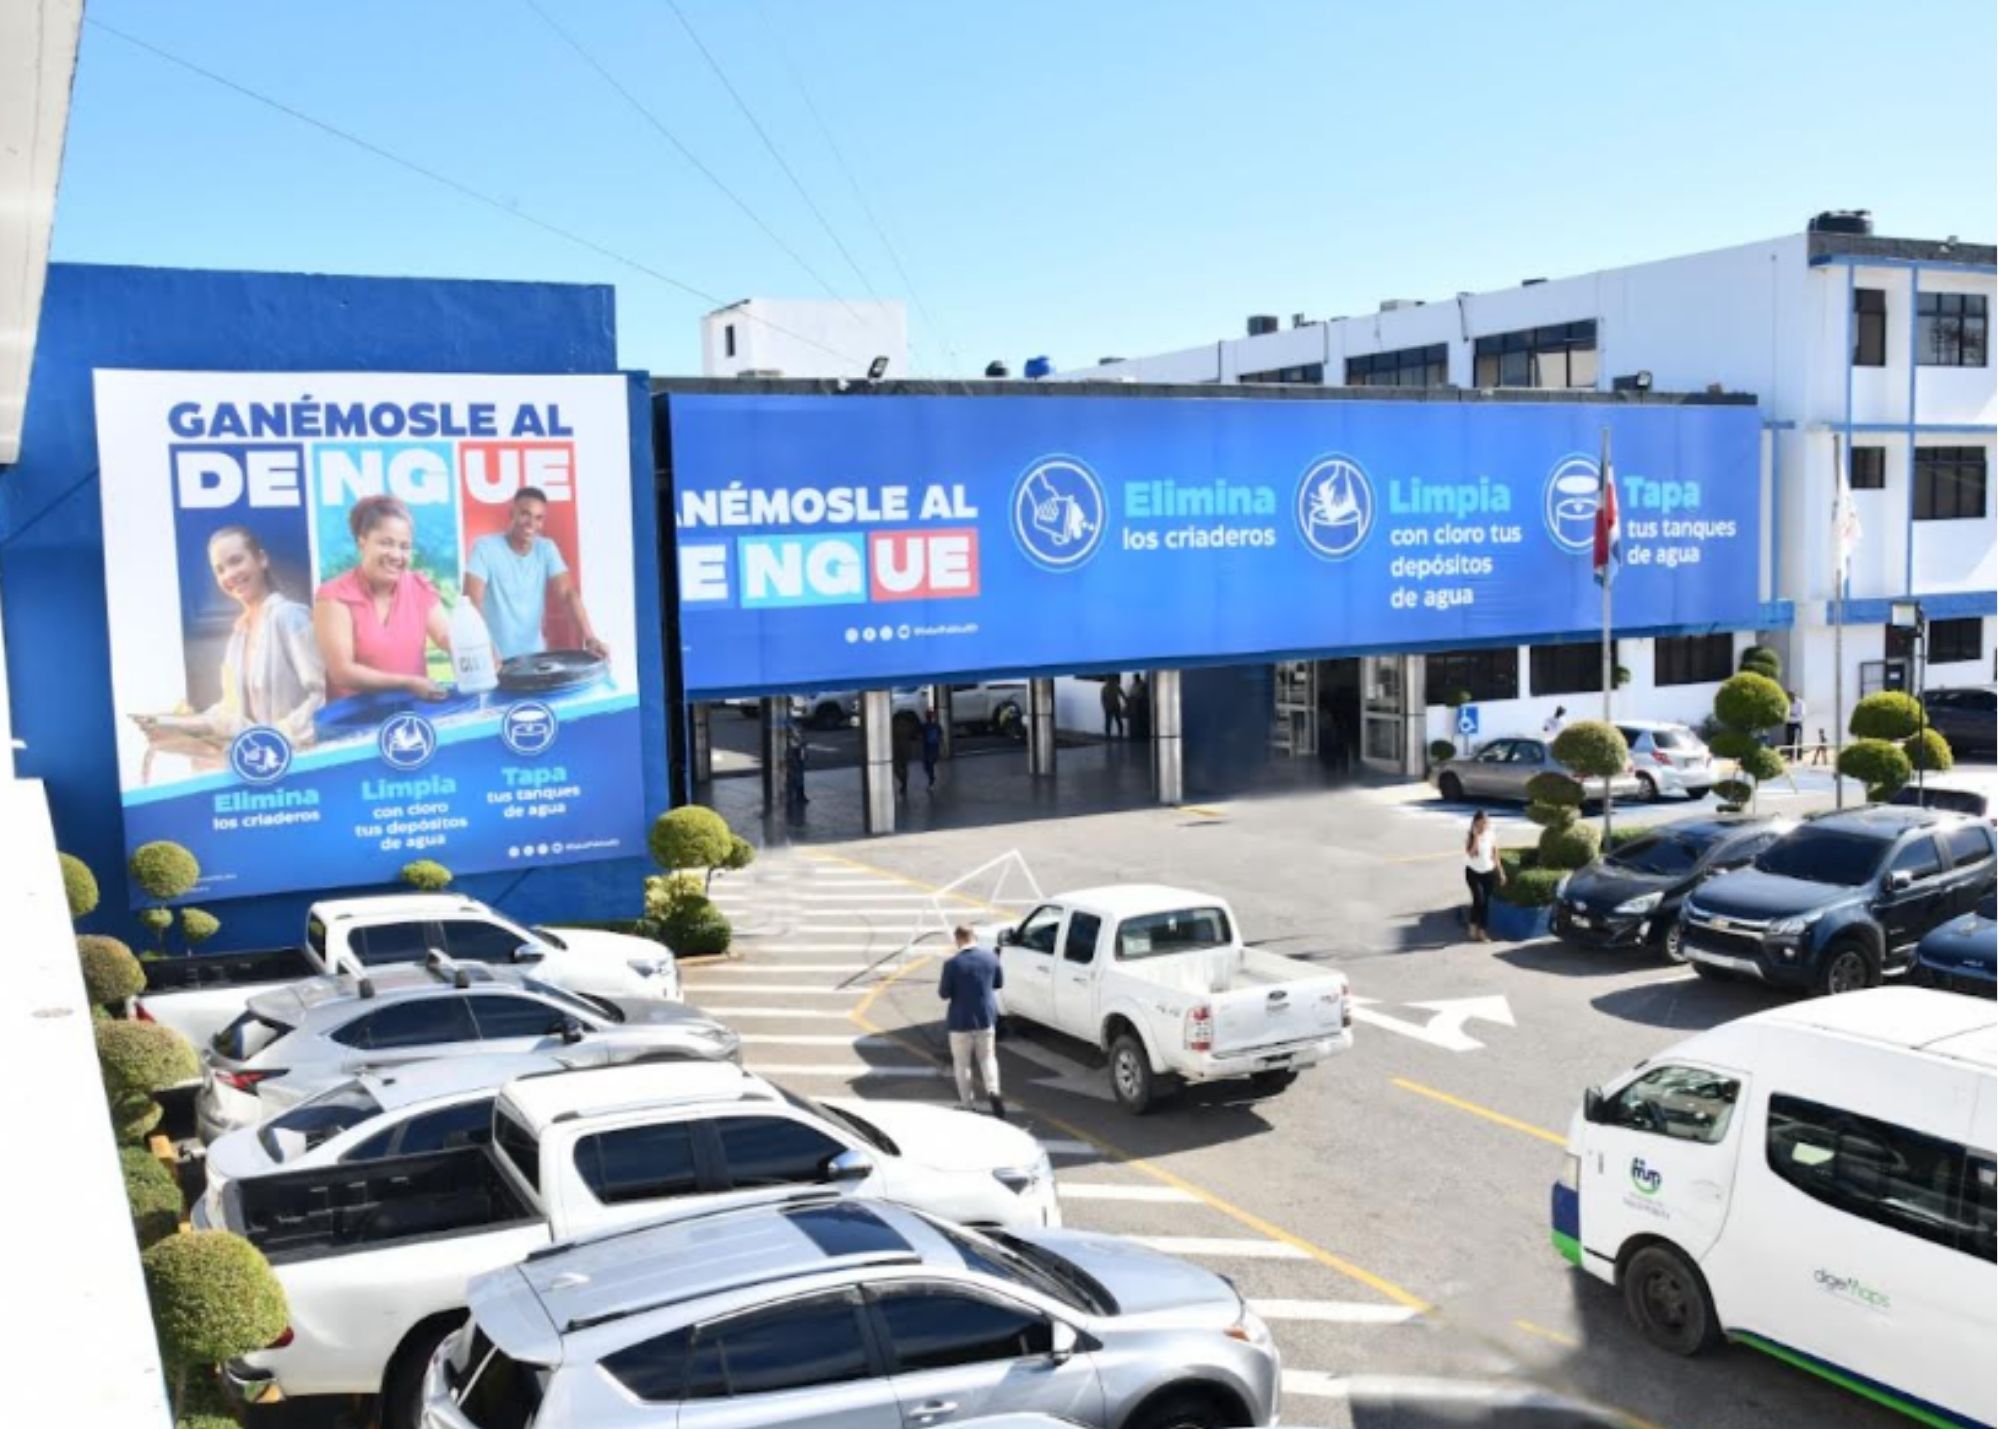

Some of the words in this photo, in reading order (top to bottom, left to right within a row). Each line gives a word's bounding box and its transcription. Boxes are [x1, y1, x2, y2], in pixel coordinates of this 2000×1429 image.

[168, 394, 497, 437] GANÉMOSLE
[510, 403, 573, 436] AL
[676, 481, 909, 527] NÉMOSLE
[919, 484, 978, 518] AL
[1125, 479, 1276, 517] Elimina
[1390, 476, 1511, 517] Limpia
[1624, 476, 1700, 514] Tapa
[1123, 528, 1158, 550] los
[1165, 524, 1276, 548] criaderos
[1390, 529, 1428, 545] con
[1434, 524, 1482, 544] cloro
[1491, 524, 1521, 542] tus
[1627, 521, 1657, 538] tus
[1662, 519, 1736, 541] tanques
[1627, 545, 1652, 564] de
[1656, 548, 1699, 566] agua
[1390, 555, 1492, 580] depósitos
[1390, 588, 1416, 609] de
[1424, 587, 1474, 610] agua
[502, 766, 566, 788] Tapa
[362, 775, 457, 802] Limpia
[487, 790, 512, 803] tus
[516, 785, 580, 802] tanques
[214, 788, 319, 813] Elimina
[373, 806, 403, 818] con
[407, 802, 449, 816] cloro
[503, 805, 523, 818] de
[527, 803, 566, 818] agua
[214, 816, 238, 830] los
[242, 810, 320, 827] criaderos
[355, 823, 387, 837] tus
[390, 816, 468, 835] depósitos
[380, 836, 402, 850] de
[406, 834, 446, 851] agua
